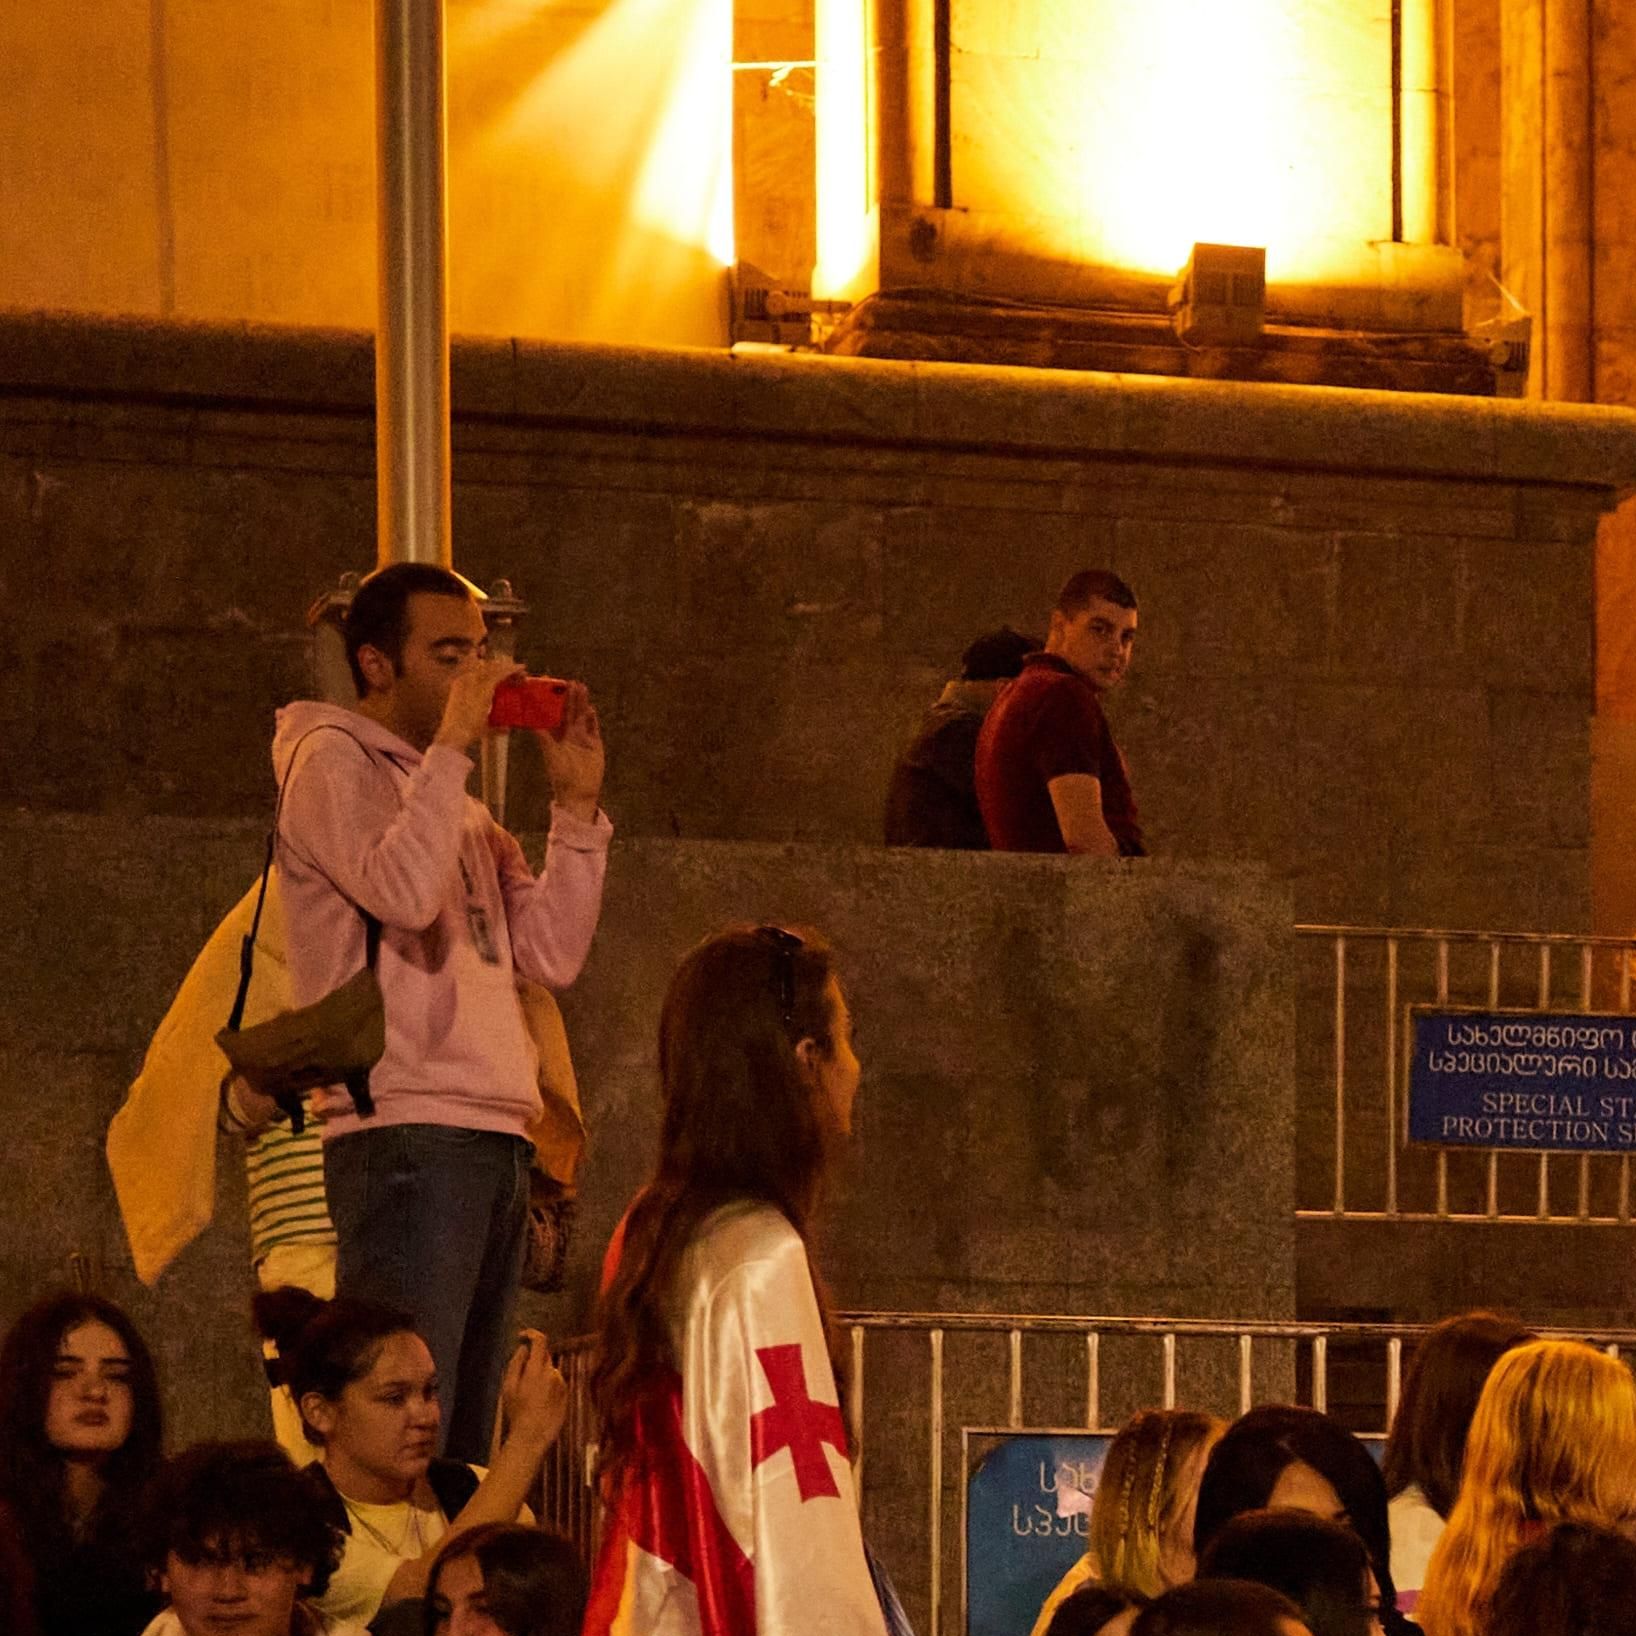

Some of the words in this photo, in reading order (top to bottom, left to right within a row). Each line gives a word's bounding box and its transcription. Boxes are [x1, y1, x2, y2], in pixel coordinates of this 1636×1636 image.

[1447, 1023, 1625, 1050] სახელმწიფო
[1428, 1050, 1598, 1078] სპეციალური
[1482, 1091, 1590, 1117] SPECIAL
[1441, 1115, 1608, 1143] PROTECTION
